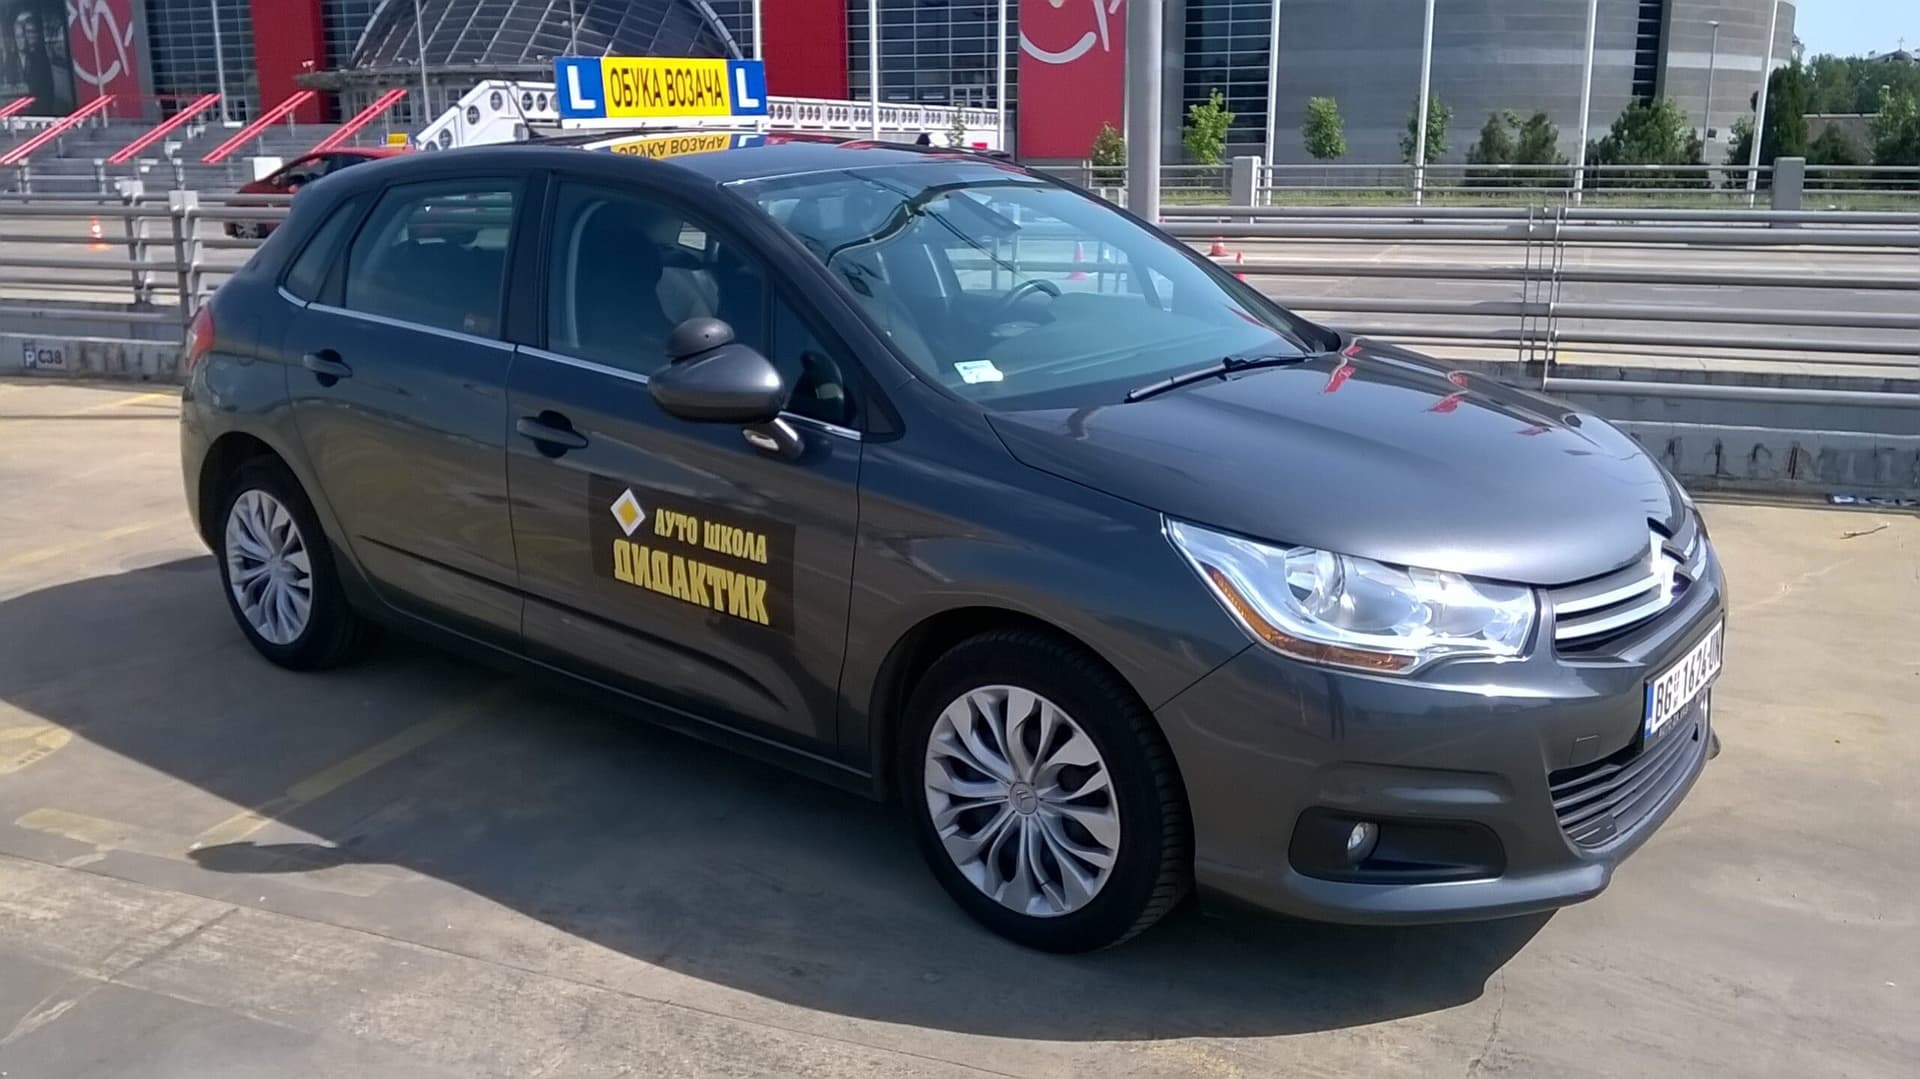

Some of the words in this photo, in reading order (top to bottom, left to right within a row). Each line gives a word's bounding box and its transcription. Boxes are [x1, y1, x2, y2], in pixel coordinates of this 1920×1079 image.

[567, 65, 596, 109] L
[610, 68, 664, 108] ОБУКА
[665, 68, 725, 107] ВОЗАЧА
[735, 67, 760, 108] L
[654, 508, 698, 545] АУТО
[704, 520, 768, 564] ШКОЛА
[613, 538, 769, 626] ДИДАКТИК
[1655, 675, 1673, 724] BG
